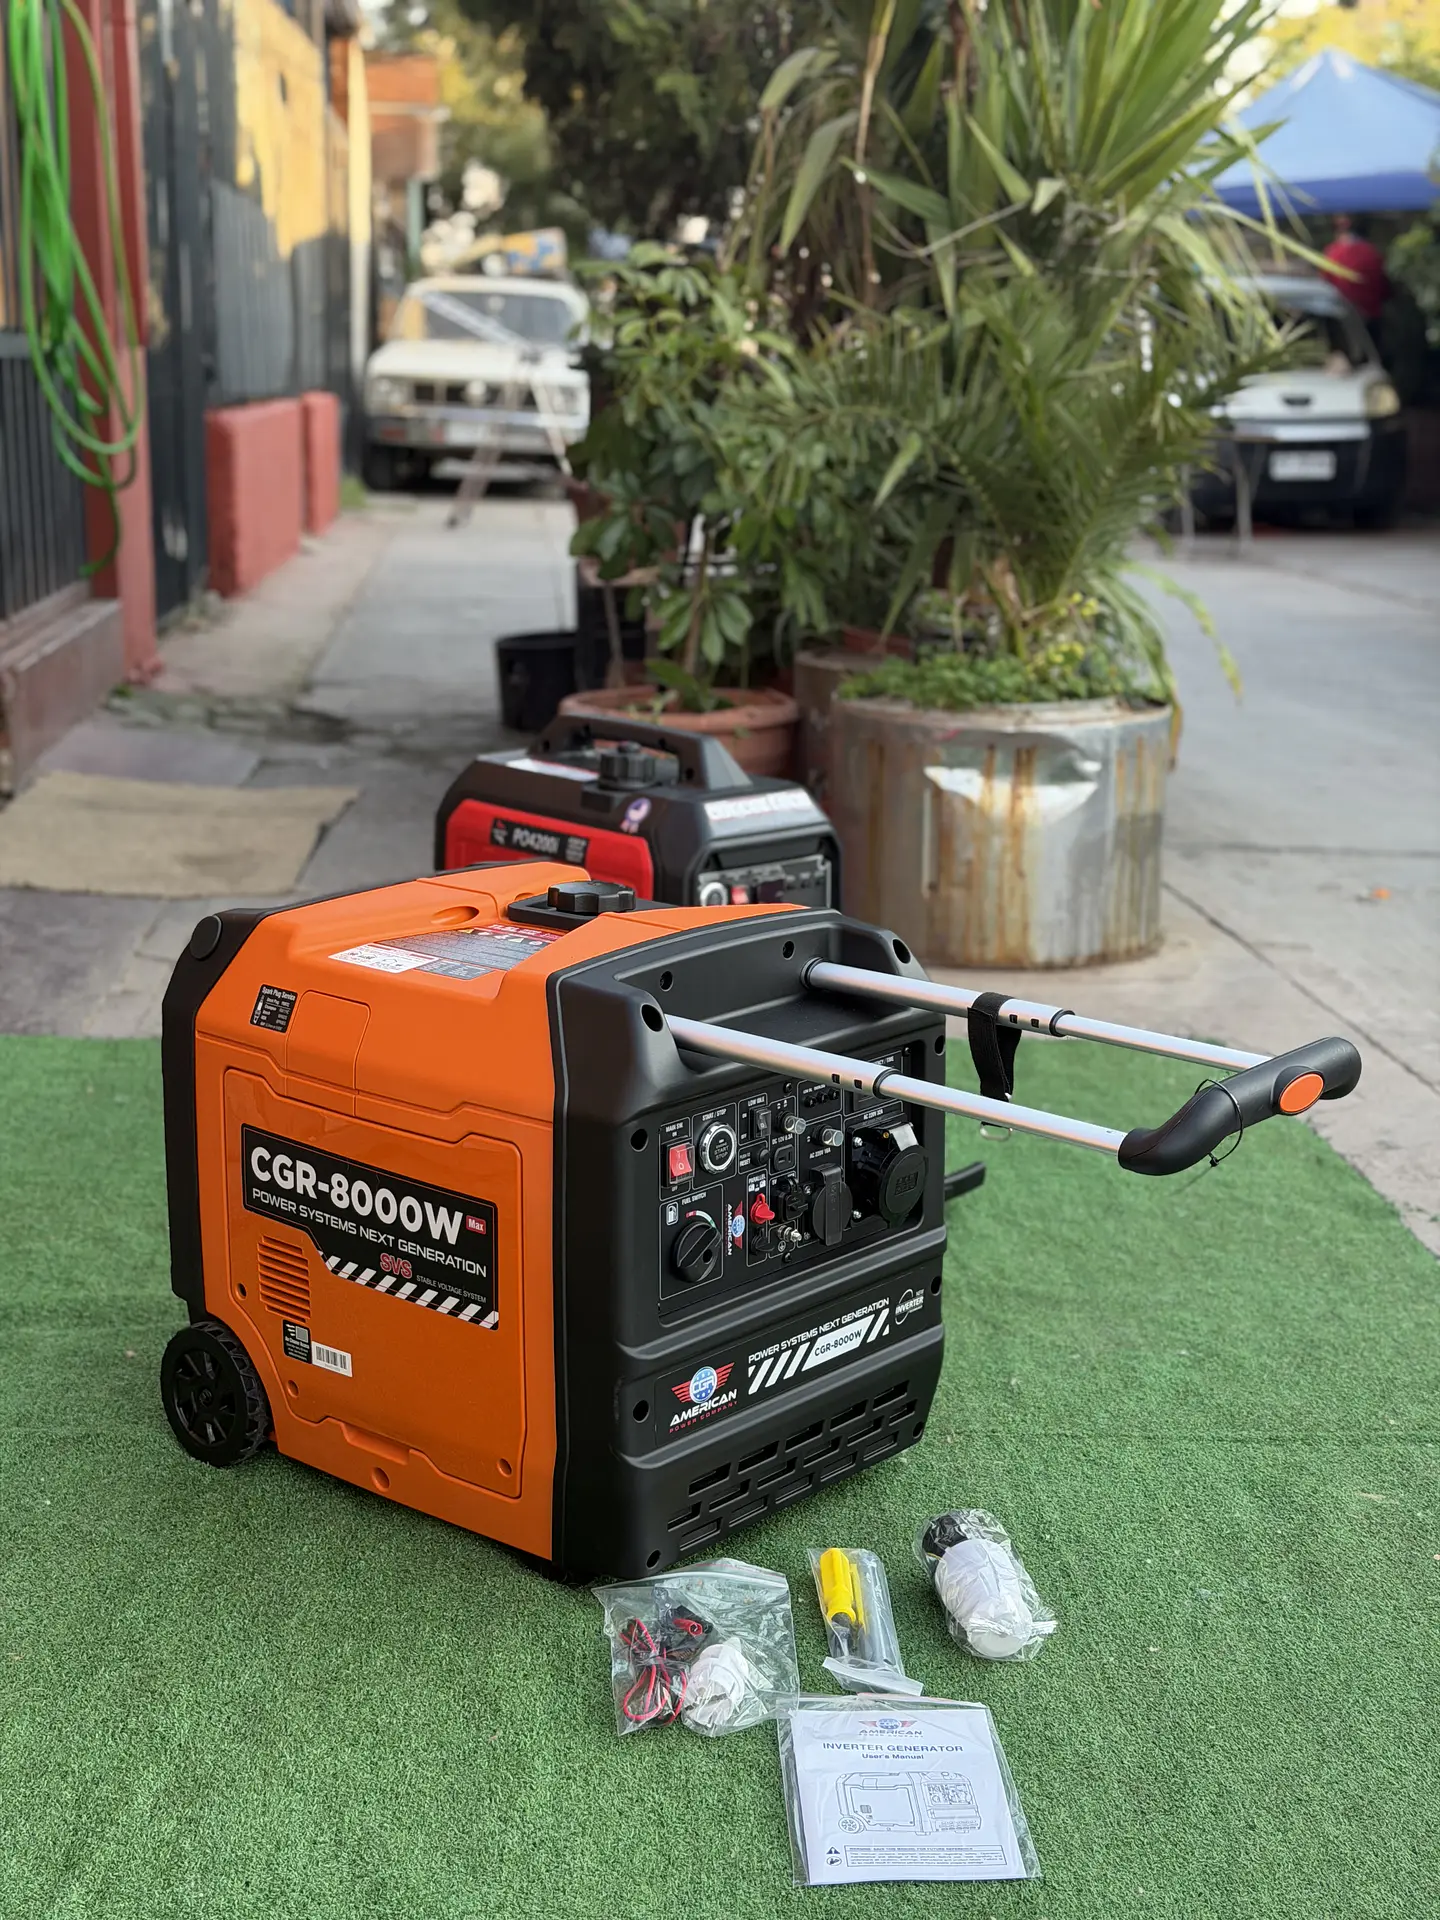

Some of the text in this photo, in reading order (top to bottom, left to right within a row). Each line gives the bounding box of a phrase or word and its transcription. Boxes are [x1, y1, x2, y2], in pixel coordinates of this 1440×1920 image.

[261, 986, 273, 995] Spark
[273, 989, 282, 999] Plug
[281, 991, 296, 1001] Service
[702, 1112, 714, 1122] START
[716, 1108, 727, 1117] STOP
[863, 1112, 870, 1120] AC
[714, 1145, 729, 1155] START
[251, 1146, 484, 1245] CGR-8000W Max
[681, 1192, 707, 1206] FUEL SWITCH
[252, 1187, 487, 1278] POWER SYSTEMS NEXT GENERATION
[380, 1252, 413, 1279] SVS
[416, 1274, 487, 1304] STABLE VOLTAGE SYSTEM
[895, 1295, 924, 1315] INVERTER
[748, 1297, 890, 1364] POWER SYSTEMS NEXT GENERATION
[813, 1328, 863, 1357] CGR-8000W
[669, 1388, 737, 1427] AMERICAN
[669, 1401, 738, 1433] POWER COMPANY
[823, 1742, 964, 1752] INVERTER GENERATOR
